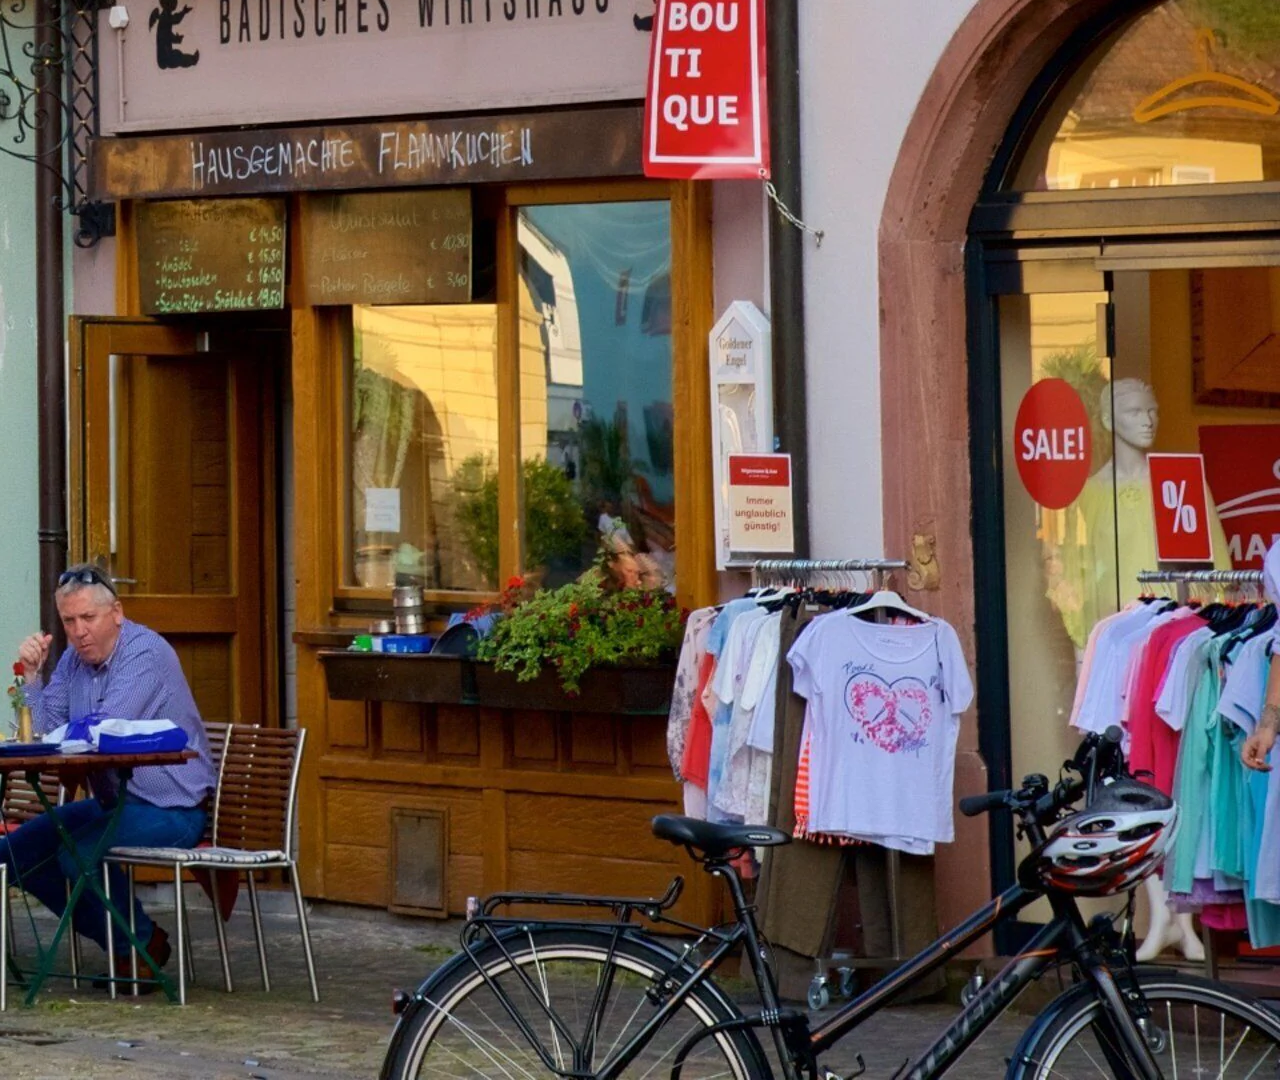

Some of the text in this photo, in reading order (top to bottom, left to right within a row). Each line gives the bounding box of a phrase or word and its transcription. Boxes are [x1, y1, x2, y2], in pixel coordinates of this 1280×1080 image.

[667, 2, 739, 32] BOU
[664, 48, 702, 78] TI
[662, 94, 740, 132] QUE
[190, 127, 534, 192] HAUSGEMACHTE FLAMMKUCHEN
[1021, 426, 1085, 461] SALE!
[735, 509, 787, 519] unglaublich
[1161, 479, 1198, 534] %
